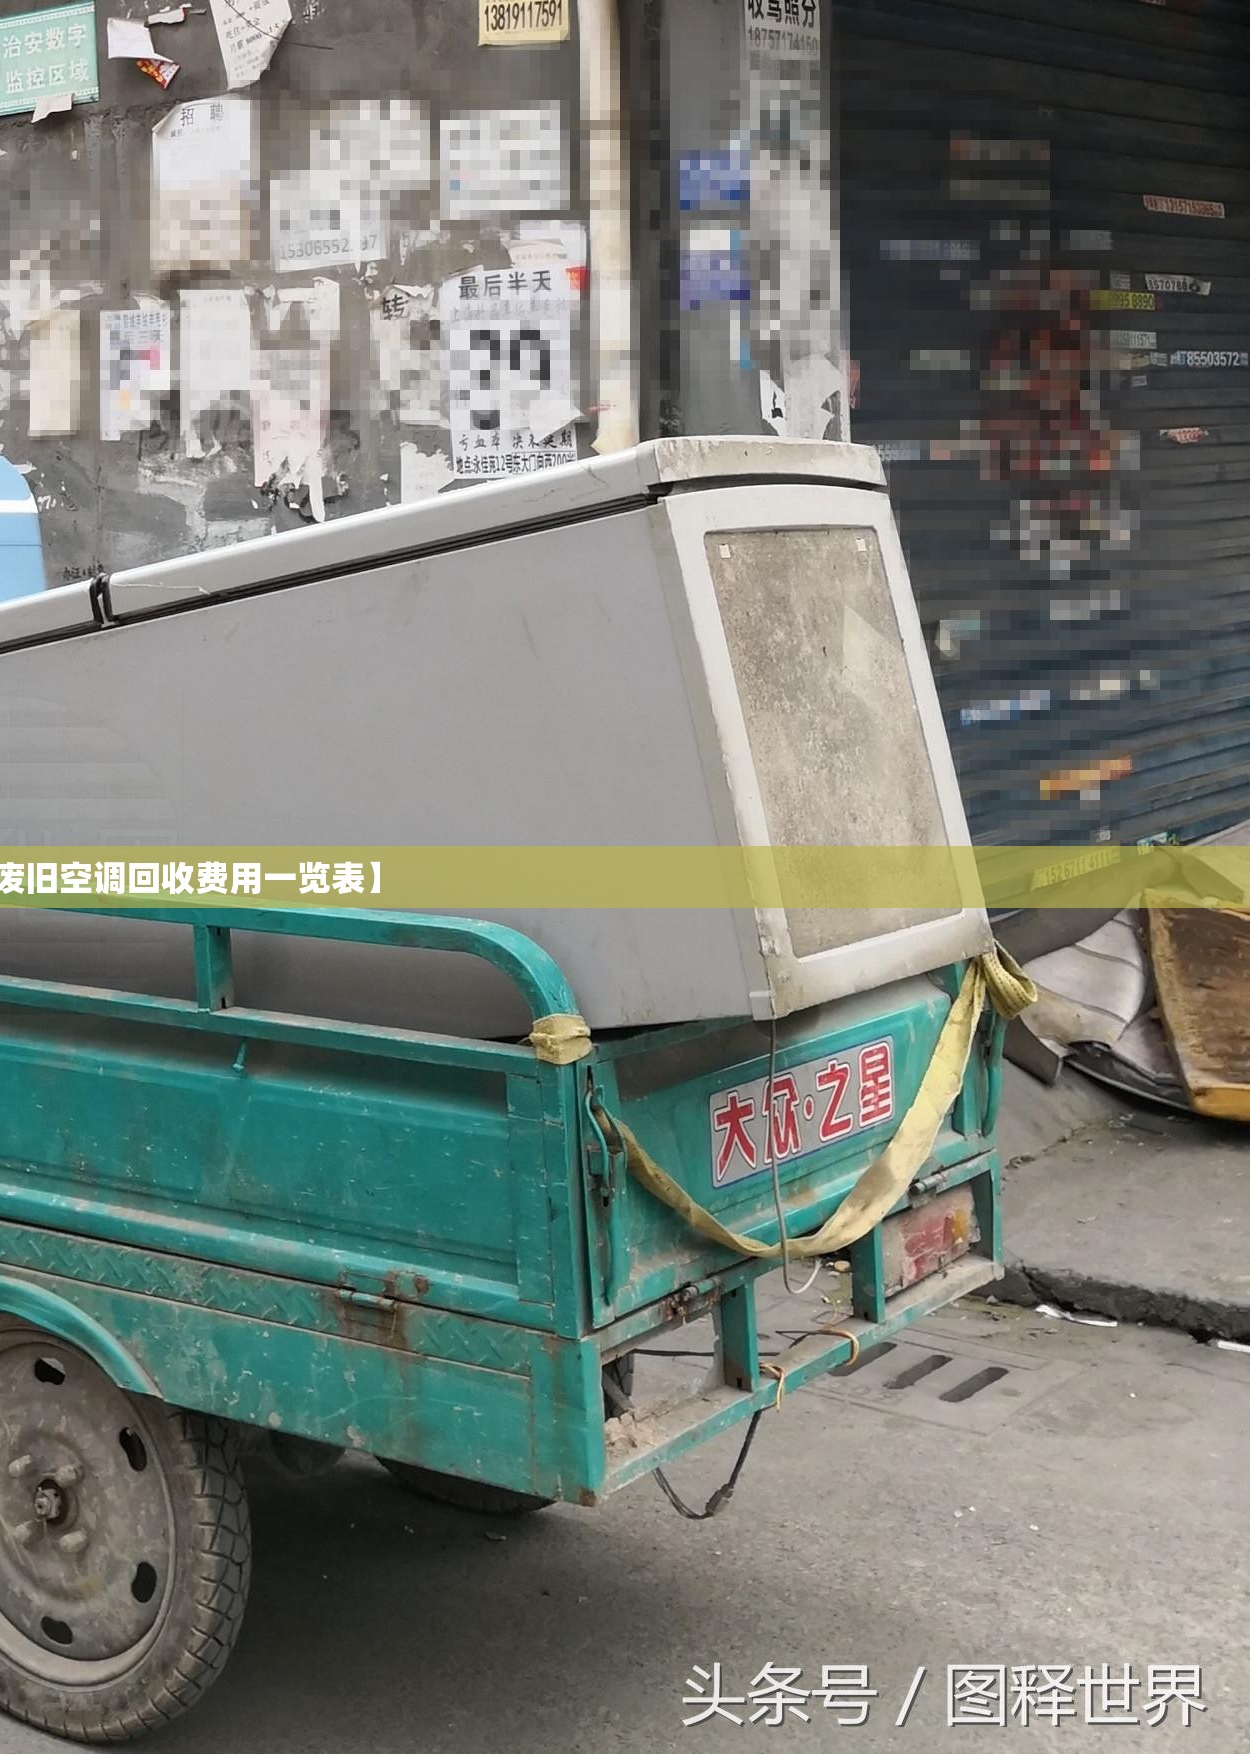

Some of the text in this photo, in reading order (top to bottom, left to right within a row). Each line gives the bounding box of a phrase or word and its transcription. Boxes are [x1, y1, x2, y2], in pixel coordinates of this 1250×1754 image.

[485, 0, 562, 32] 13819117591
[3, 23, 87, 59] 治安数字
[6, 58, 90, 94] 监控区域
[459, 270, 552, 300] 最后半天
[382, 294, 409, 320] 转
[1187, 350, 1240, 367] 85503572
